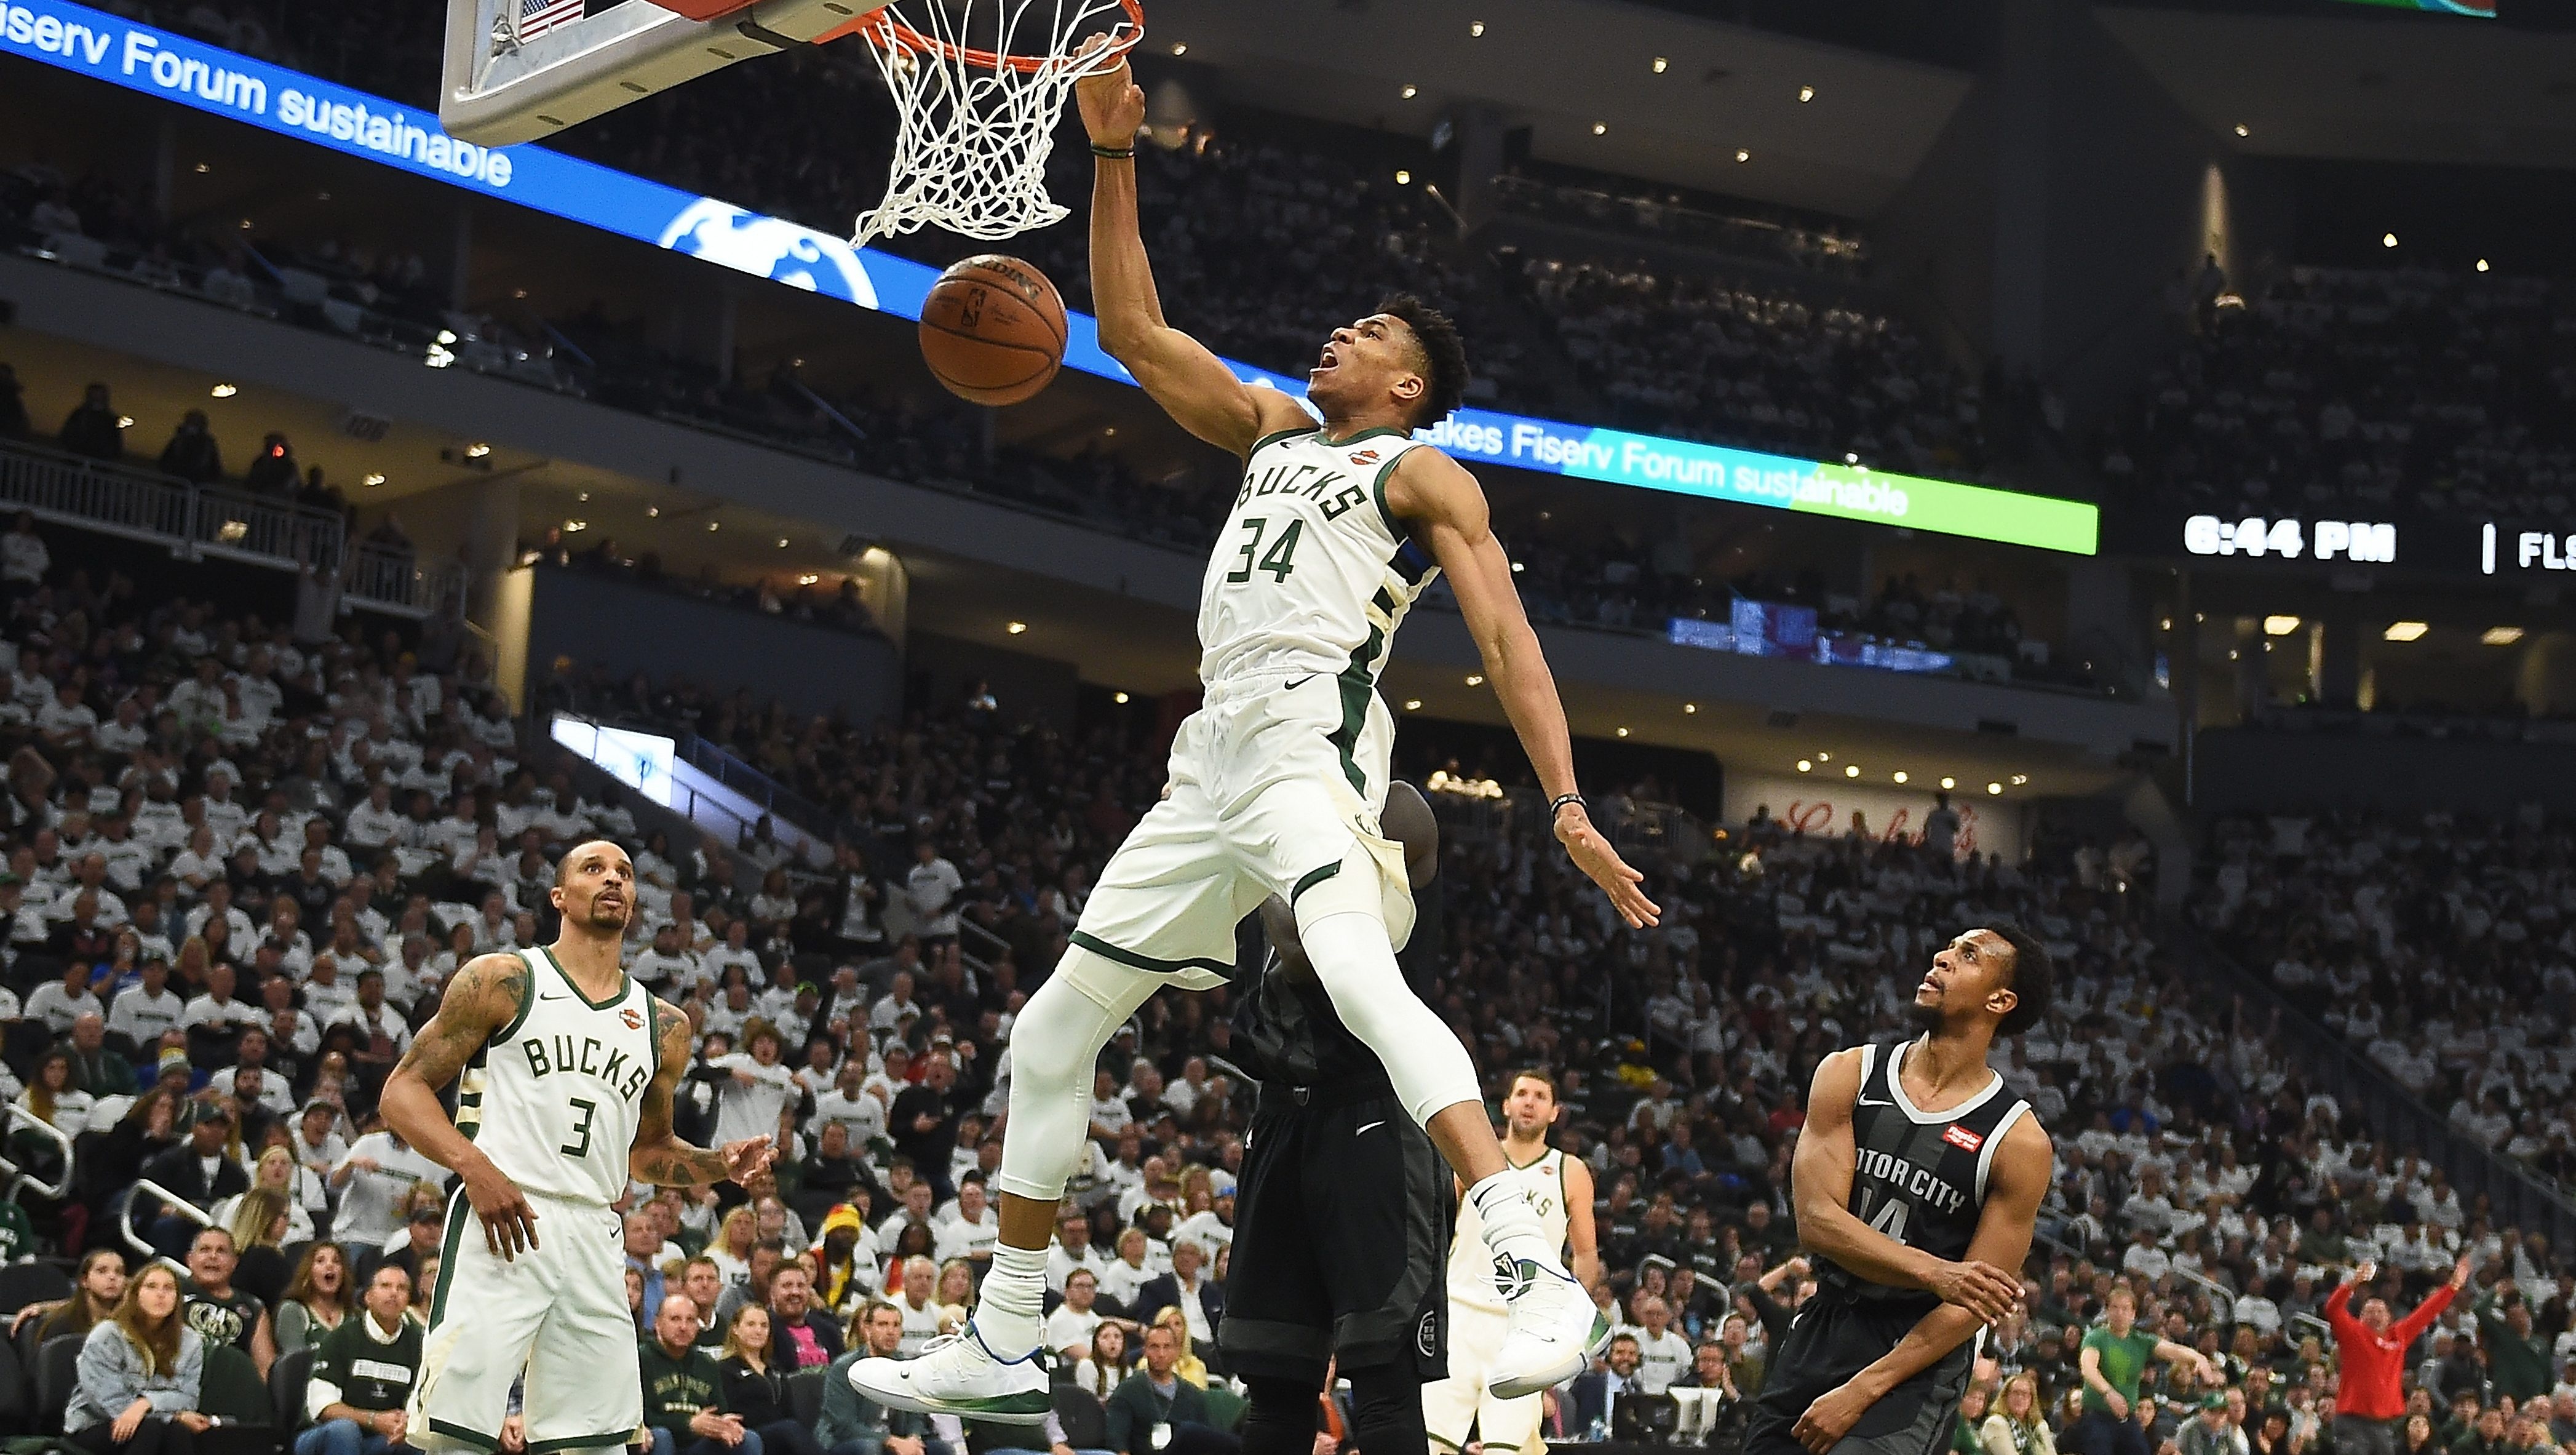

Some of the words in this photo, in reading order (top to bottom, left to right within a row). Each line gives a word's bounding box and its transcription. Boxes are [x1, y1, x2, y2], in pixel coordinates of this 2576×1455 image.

[123, 30, 267, 115] Forum
[278, 88, 513, 188] sustainable
[1237, 464, 1368, 522] BUCKS
[1511, 424, 1615, 471] Fiserv
[1621, 441, 1725, 488] Forum
[1735, 465, 1909, 517] sustainable
[1226, 517, 1304, 584] 34
[2184, 515, 2304, 558] 6:44
[2315, 520, 2396, 563] PM
[522, 1034, 647, 1104] BUCKS
[560, 1097, 597, 1158] 3
[1909, 1168, 1966, 1214] CITY
